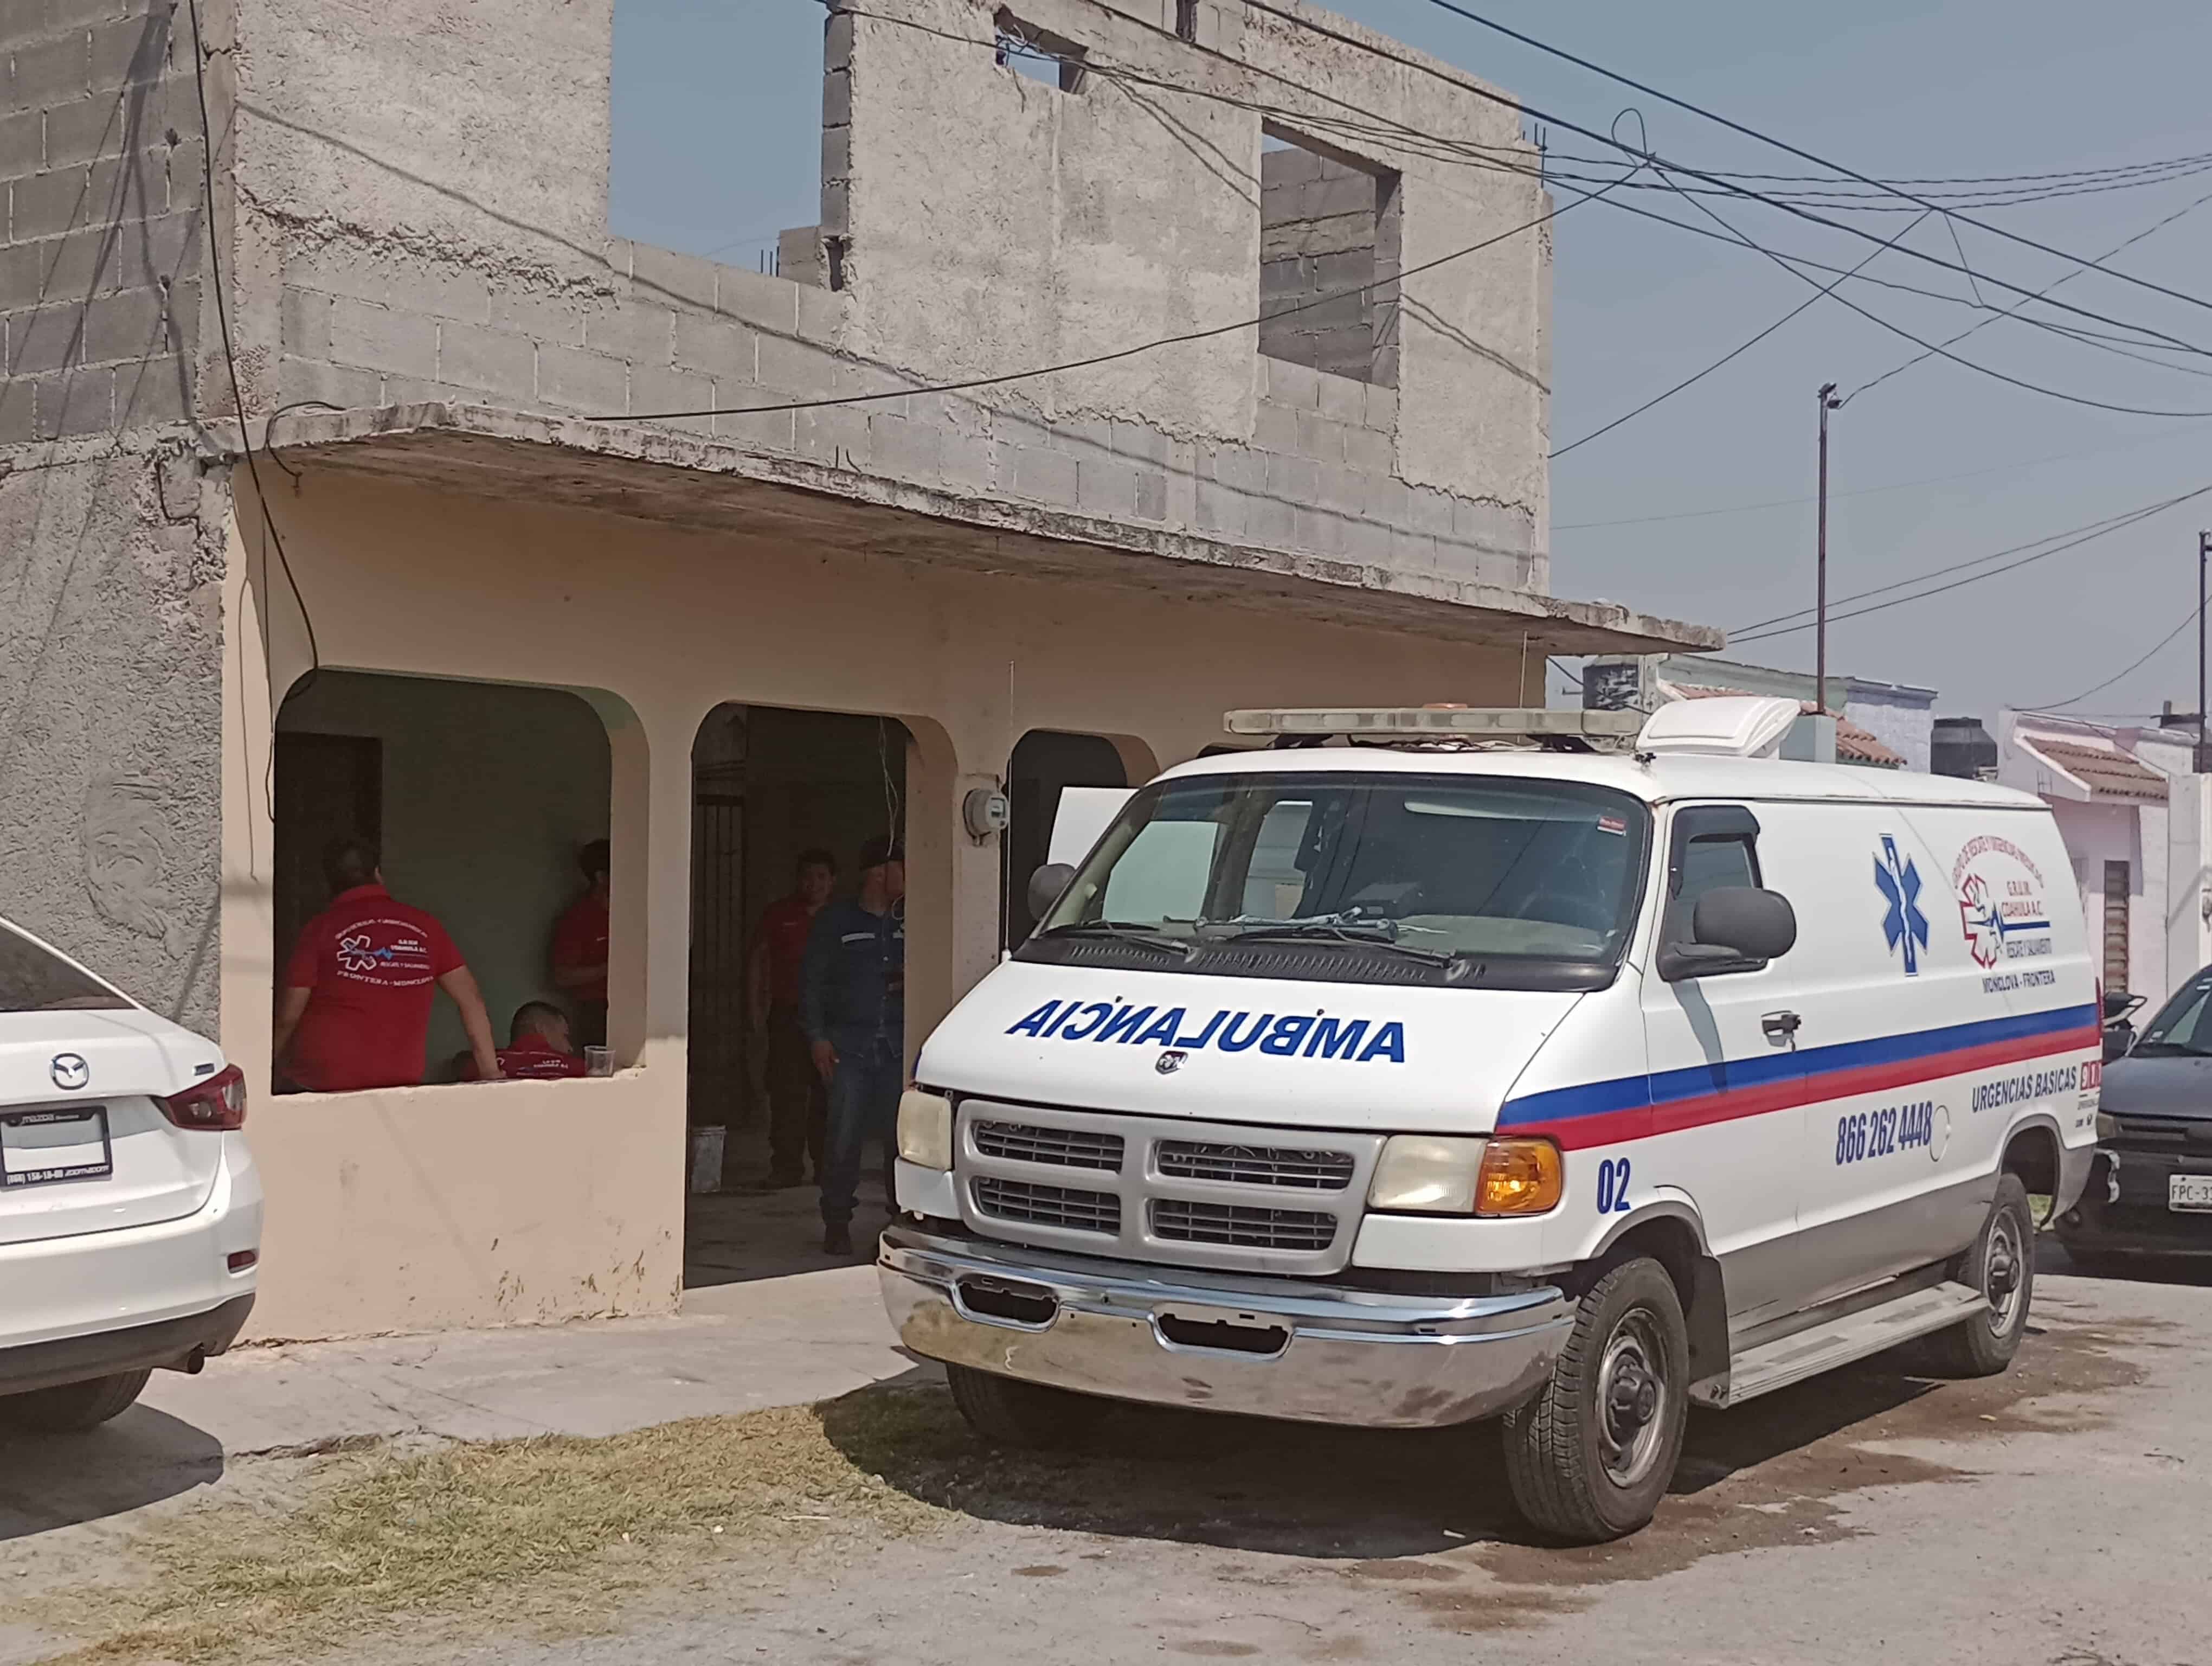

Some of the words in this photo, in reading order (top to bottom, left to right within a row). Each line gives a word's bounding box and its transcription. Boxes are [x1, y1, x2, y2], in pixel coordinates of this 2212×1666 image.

[2022, 970, 2056, 988] FRONTERA
[1972, 1074, 2032, 1113] URGENCIAS
[2035, 1066, 2076, 1098] BASICAS
[1835, 1113, 1866, 1165] 866
[1868, 1107, 1896, 1158] 262
[1898, 1101, 1933, 1150] 4448
[1597, 1157, 1631, 1214] 02
[2171, 1184, 2212, 1201] FPC-3
